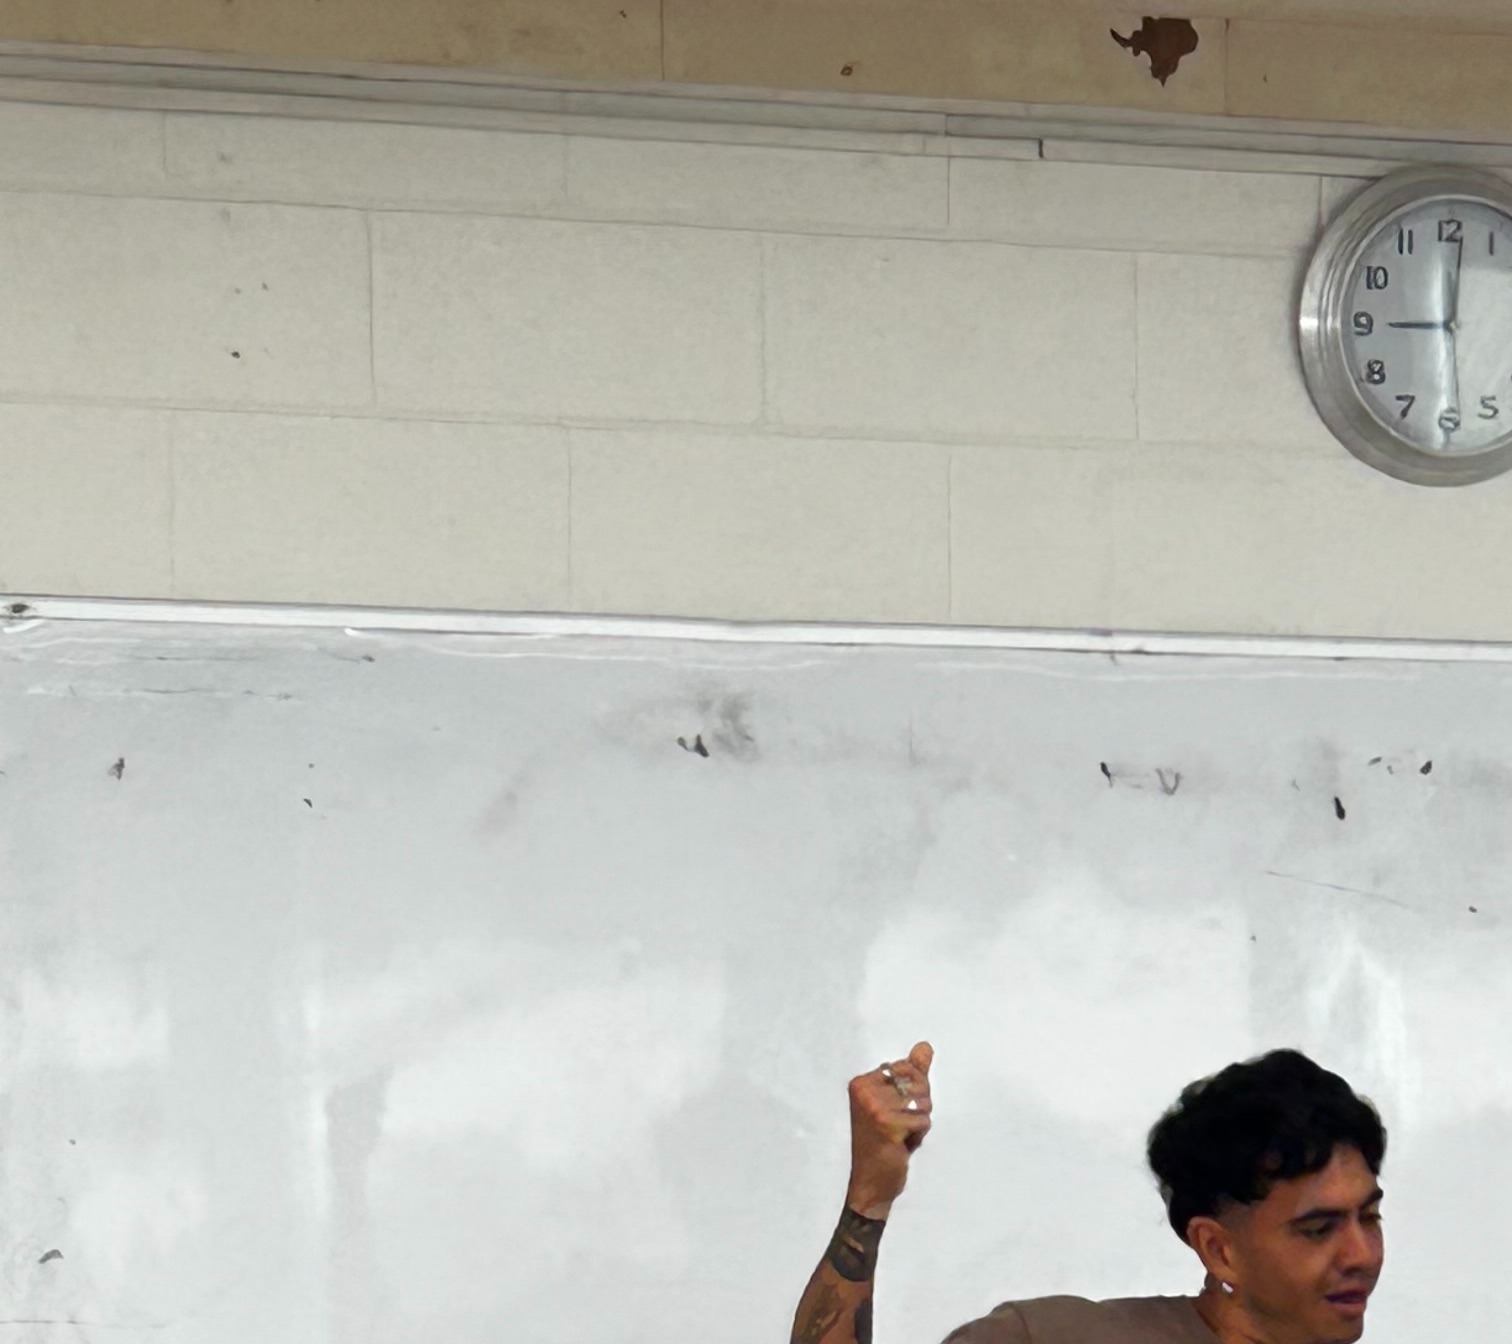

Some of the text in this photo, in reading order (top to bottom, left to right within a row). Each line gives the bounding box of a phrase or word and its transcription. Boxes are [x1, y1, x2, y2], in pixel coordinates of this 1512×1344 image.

[1397, 228, 1414, 256] 11
[1437, 219, 1462, 243] 12
[1487, 230, 1495, 256] 1
[1365, 265, 1389, 290] 10
[1352, 311, 1374, 336] 9
[1365, 359, 1387, 385] 8
[1394, 394, 1416, 419] 7
[1477, 395, 1500, 420] 5
